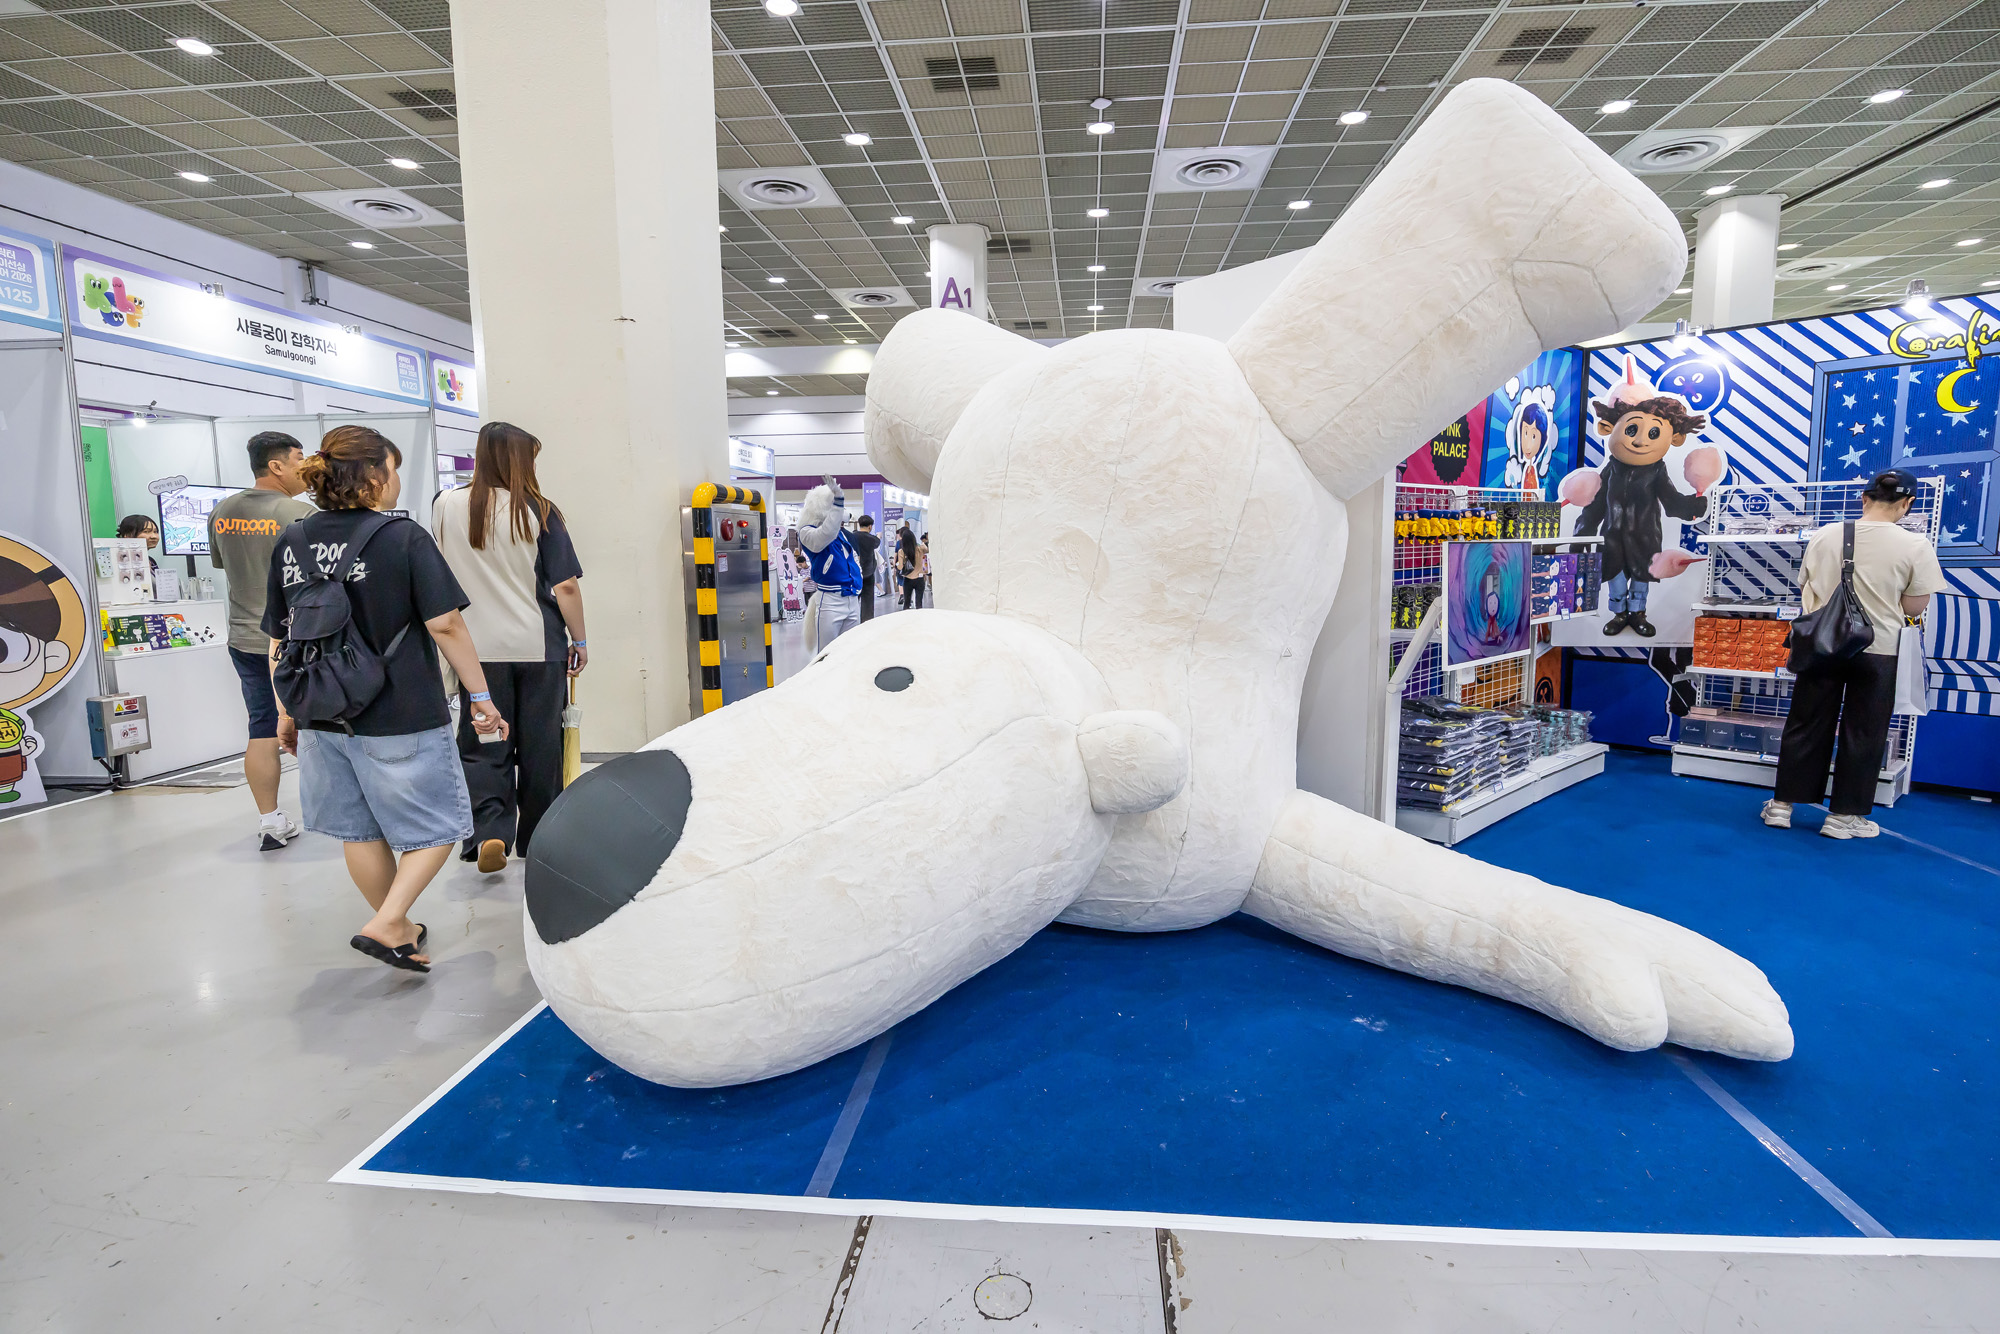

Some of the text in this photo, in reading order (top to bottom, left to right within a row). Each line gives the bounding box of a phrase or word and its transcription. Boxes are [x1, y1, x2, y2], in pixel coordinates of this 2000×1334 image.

[11, 270, 32, 284] 2026
[940, 277, 971, 308] A1
[236, 317, 338, 357] 사물궁이 잡학지식
[264, 344, 317, 366] Samulgoongi
[1441, 423, 1462, 438] INK
[1433, 441, 1467, 458] PALACE
[215, 518, 277, 536] OUTDOOR
[191, 543, 209, 552] 지식
